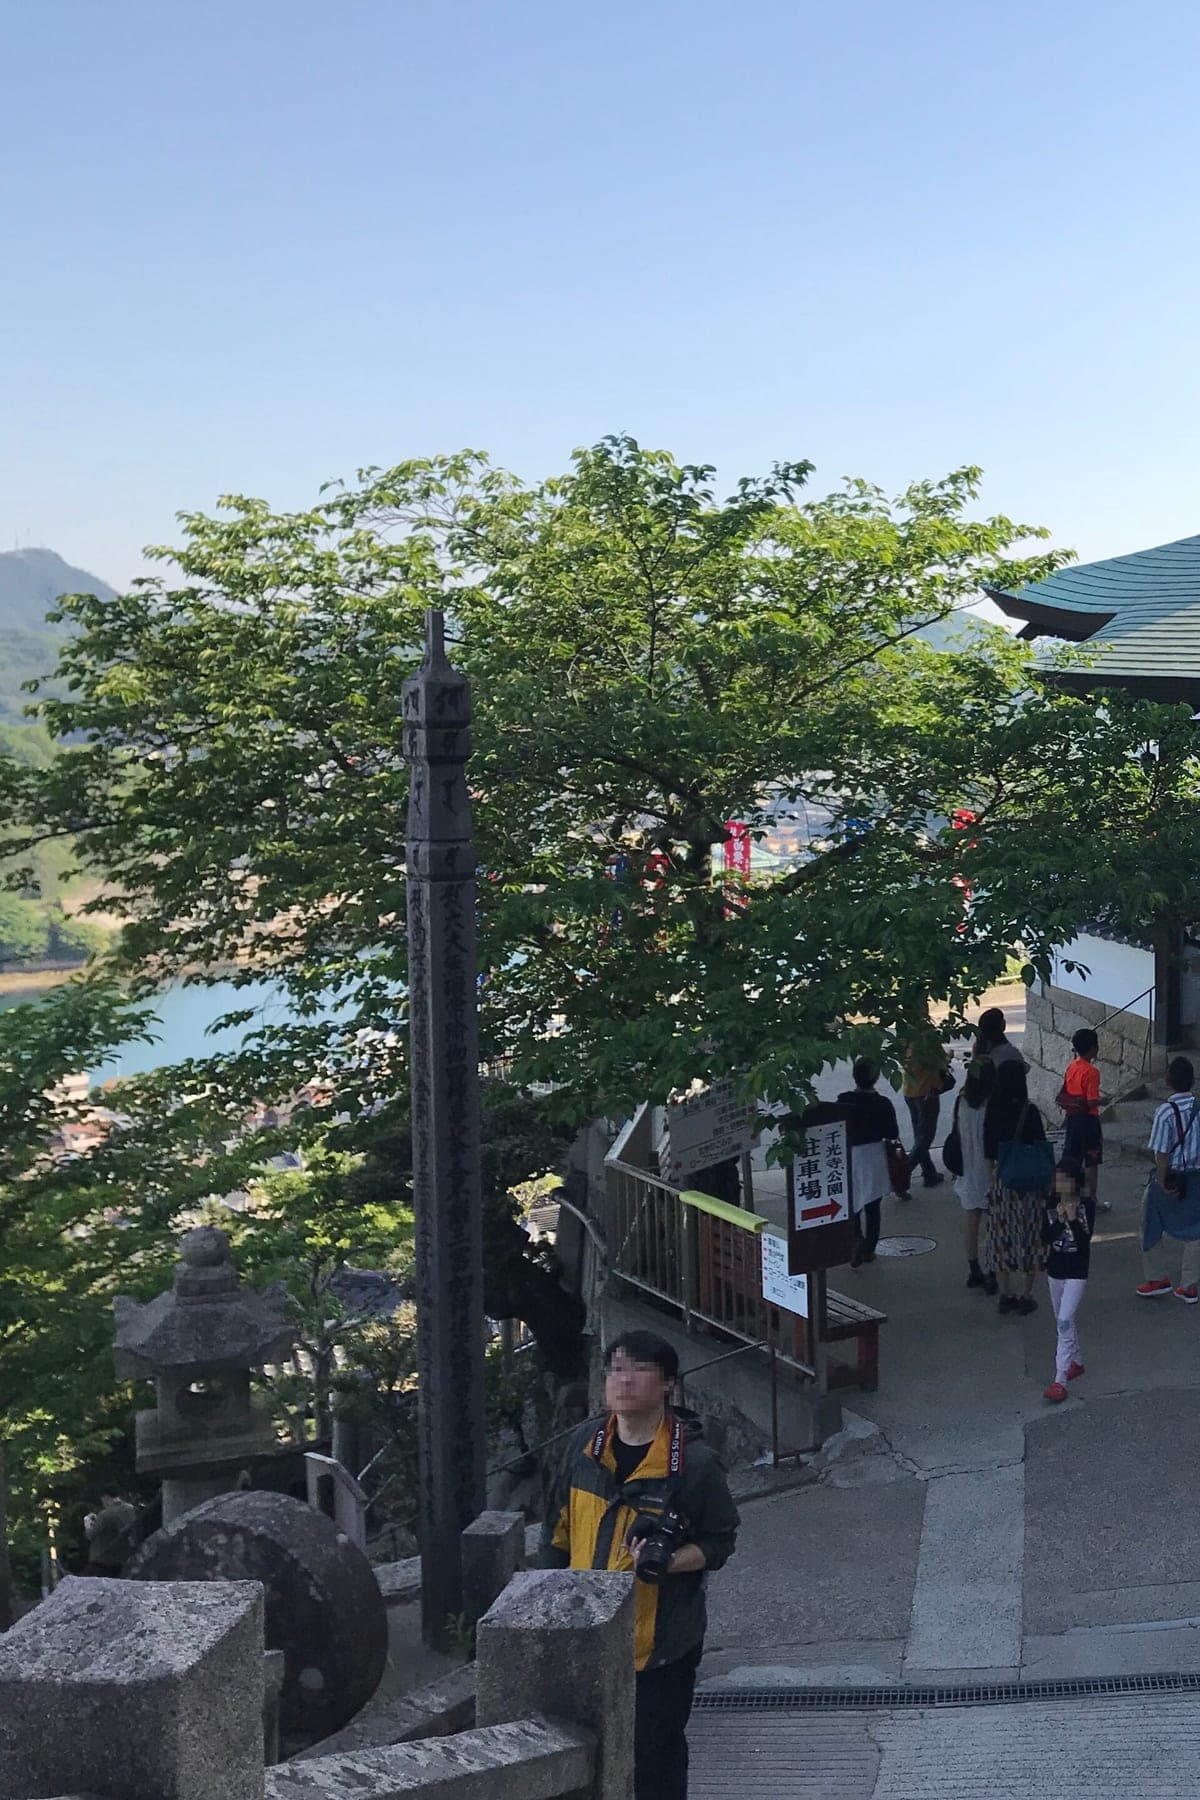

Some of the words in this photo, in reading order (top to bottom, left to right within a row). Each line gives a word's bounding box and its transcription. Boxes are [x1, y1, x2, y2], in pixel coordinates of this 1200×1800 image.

[825, 1130, 843, 1196] 千光寺公園
[671, 1451, 679, 1472] EOS
